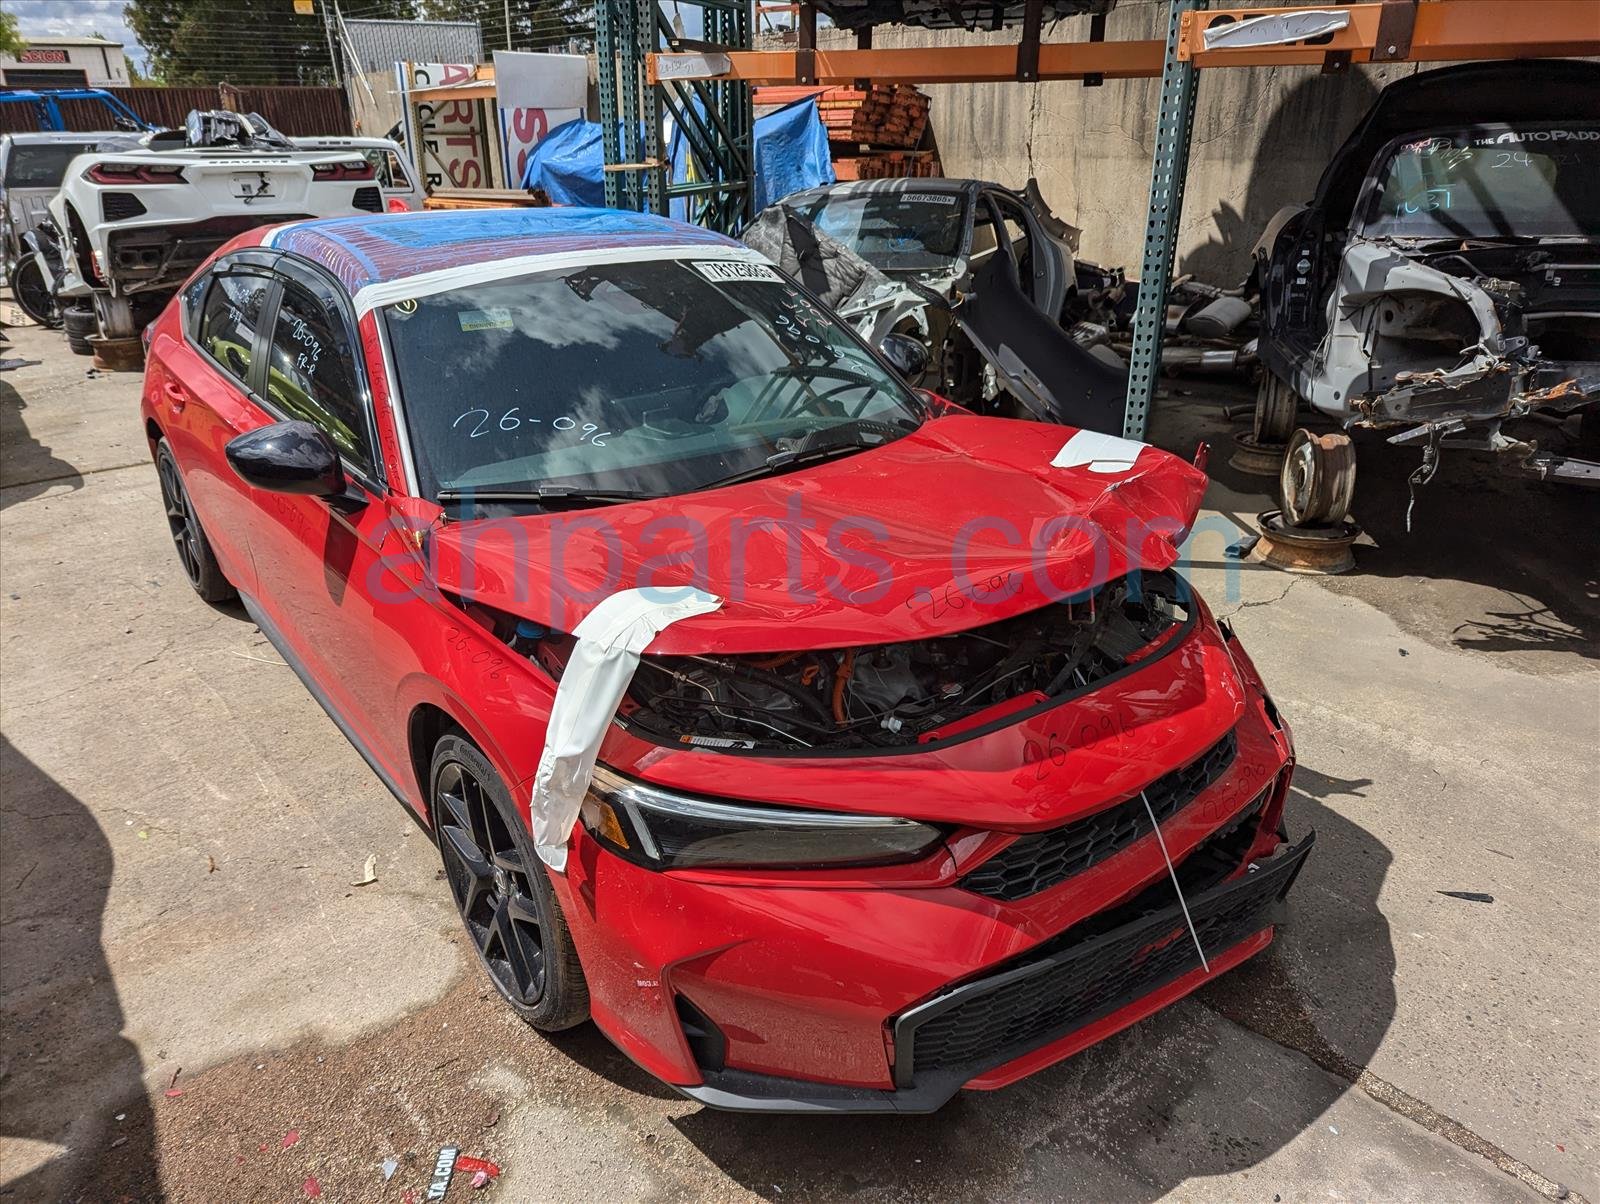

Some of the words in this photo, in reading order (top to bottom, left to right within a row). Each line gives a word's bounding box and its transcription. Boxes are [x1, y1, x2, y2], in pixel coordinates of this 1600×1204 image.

[22, 51, 65, 62] SCION
[1474, 137, 1494, 145] THE
[292, 319, 322, 361] 26-096
[453, 407, 611, 447] 26-096
